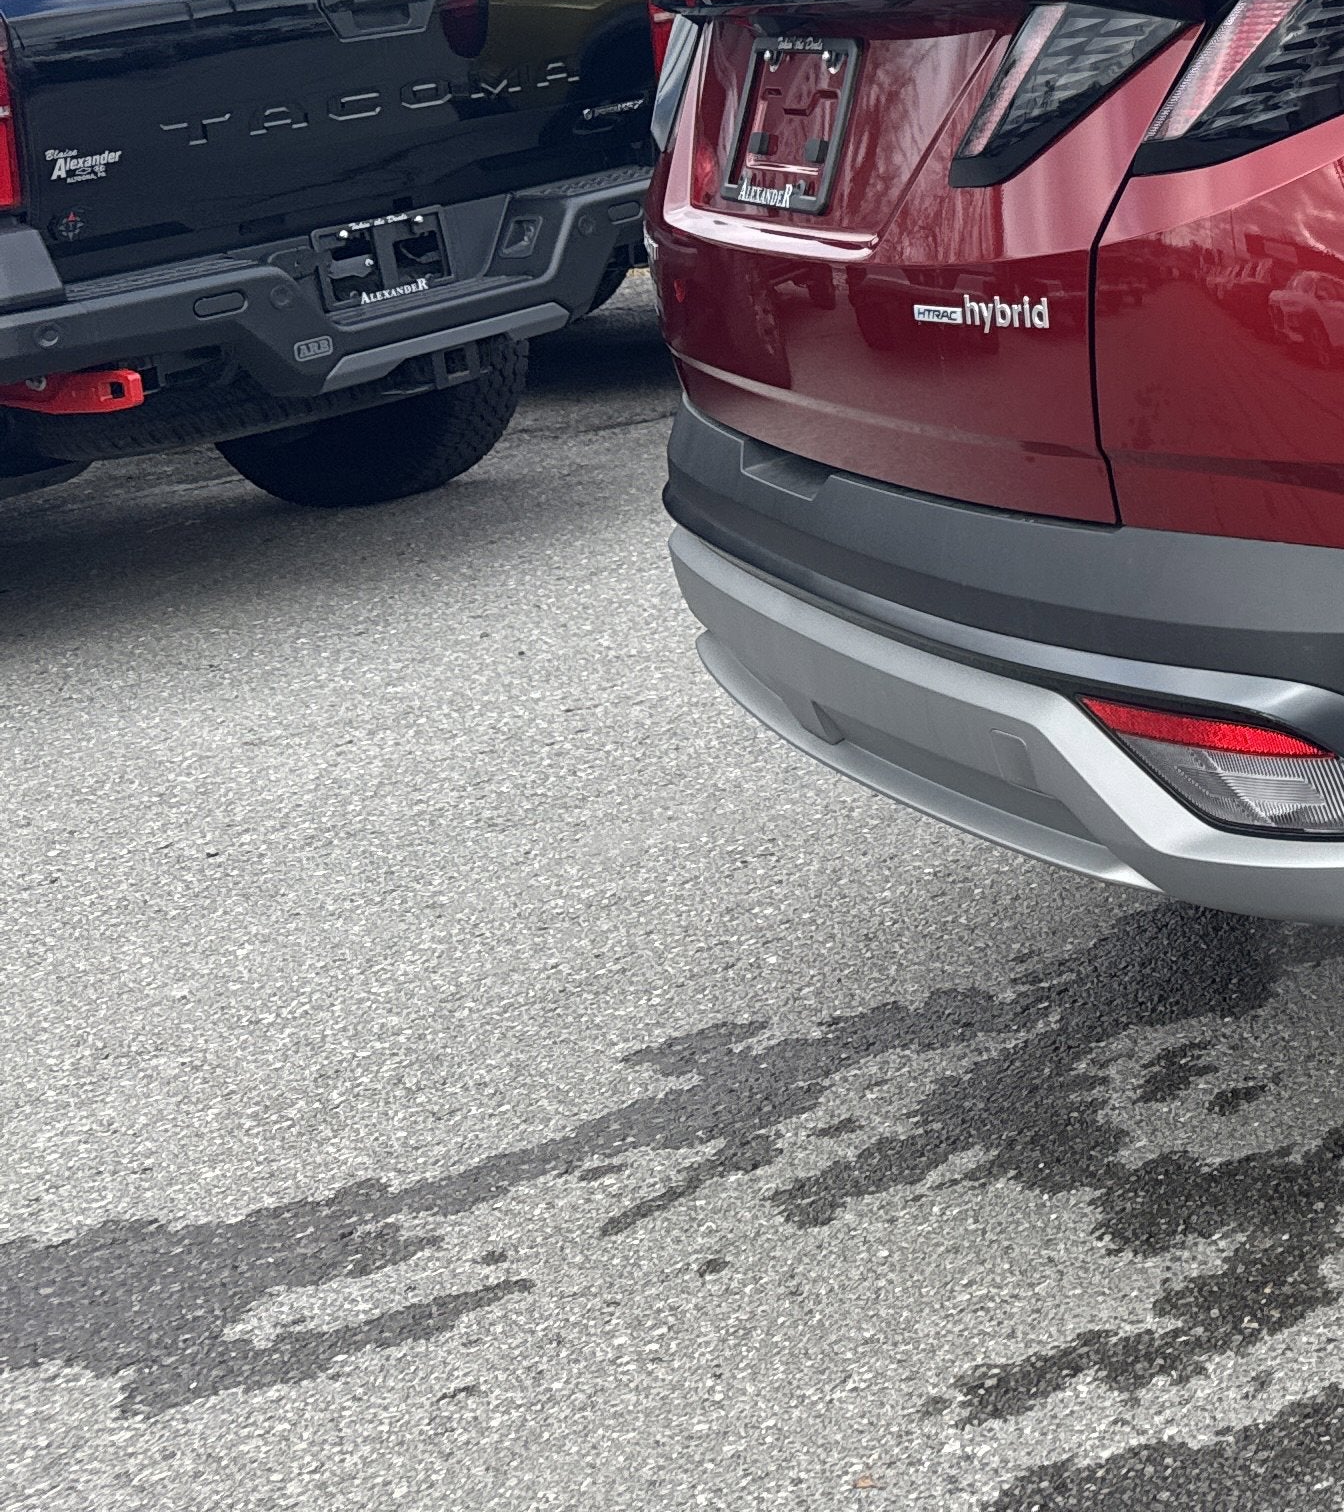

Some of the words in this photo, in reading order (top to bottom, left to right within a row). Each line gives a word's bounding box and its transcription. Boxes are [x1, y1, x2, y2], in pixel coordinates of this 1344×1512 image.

[159, 61, 580, 146] TACOMA
[45, 149, 78, 160] Blaise
[51, 150, 122, 180] Alexander
[738, 178, 793, 208] ALEXANDER
[361, 278, 428, 304] ALEXANDER
[917, 308, 958, 321] HTRAC
[963, 294, 1050, 333] hybrid
[299, 340, 329, 358] ARB
